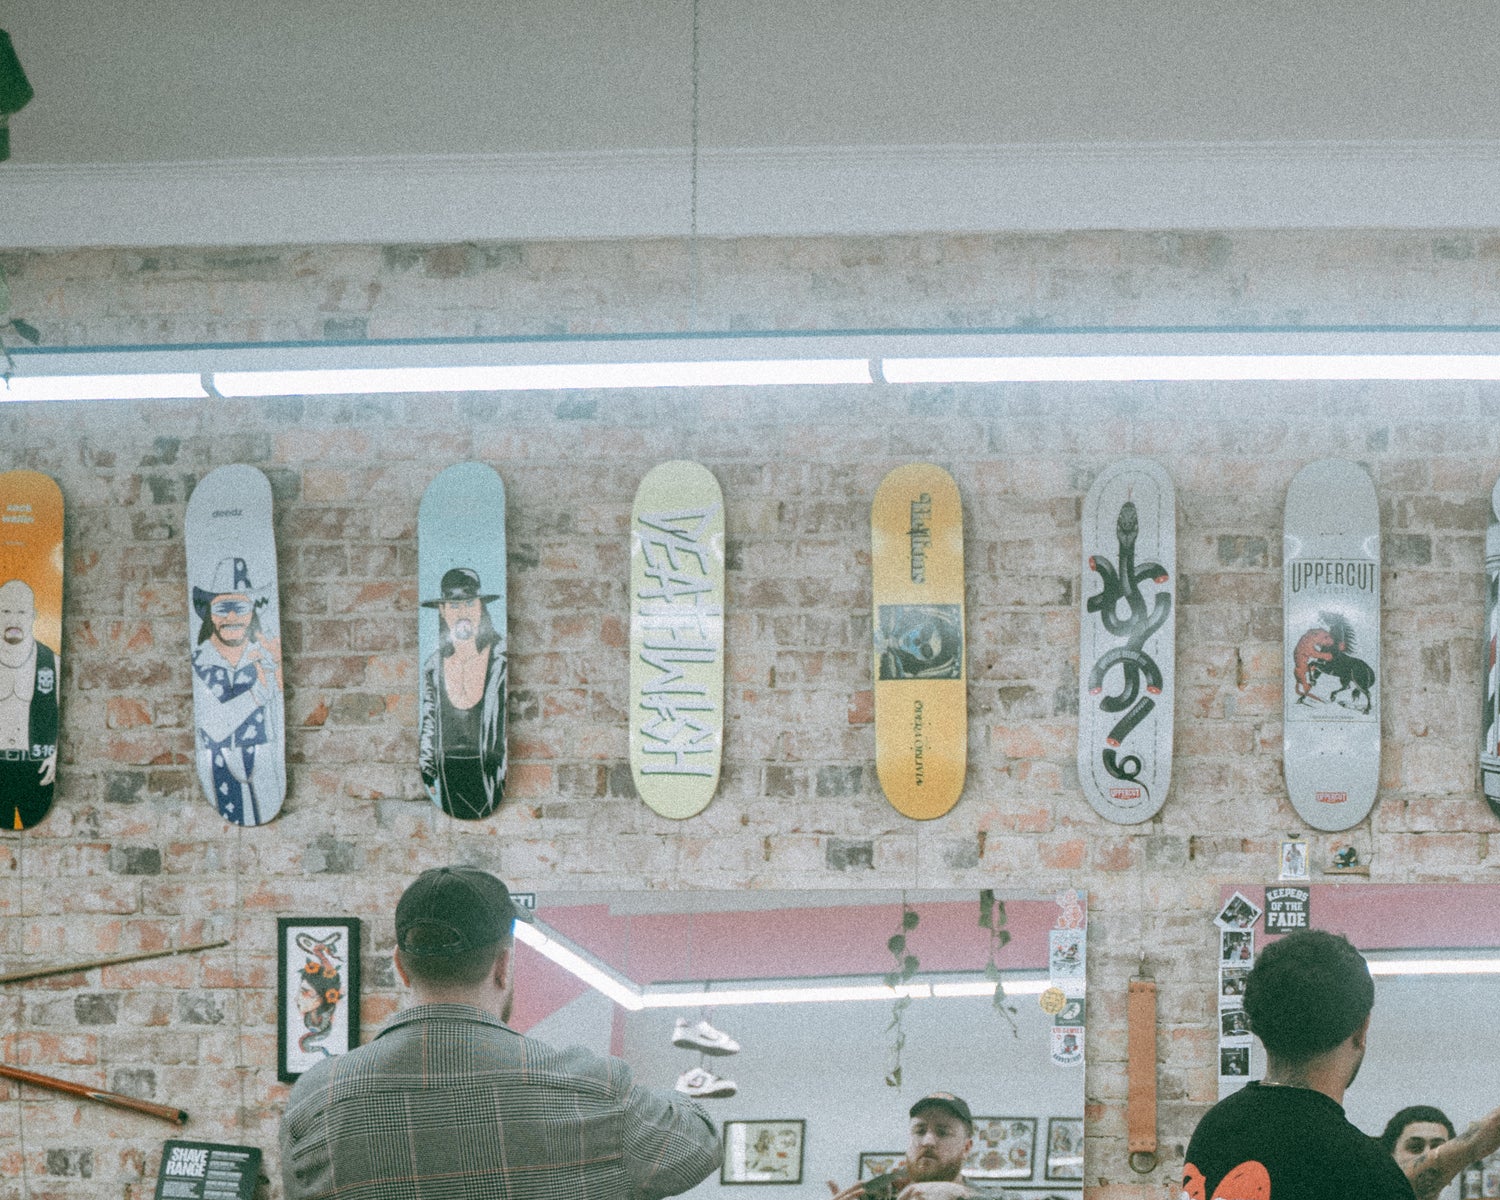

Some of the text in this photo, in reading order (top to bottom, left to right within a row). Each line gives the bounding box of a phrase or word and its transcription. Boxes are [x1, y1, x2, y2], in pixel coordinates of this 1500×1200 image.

[1291, 562, 1376, 593] UPPERCUT
[1266, 888, 1309, 902] KEEPERS
[1271, 902, 1304, 911] OF THE
[1267, 912, 1307, 927] FADE
[171, 1147, 209, 1163] SHAVE
[165, 1160, 206, 1178] RANGE
